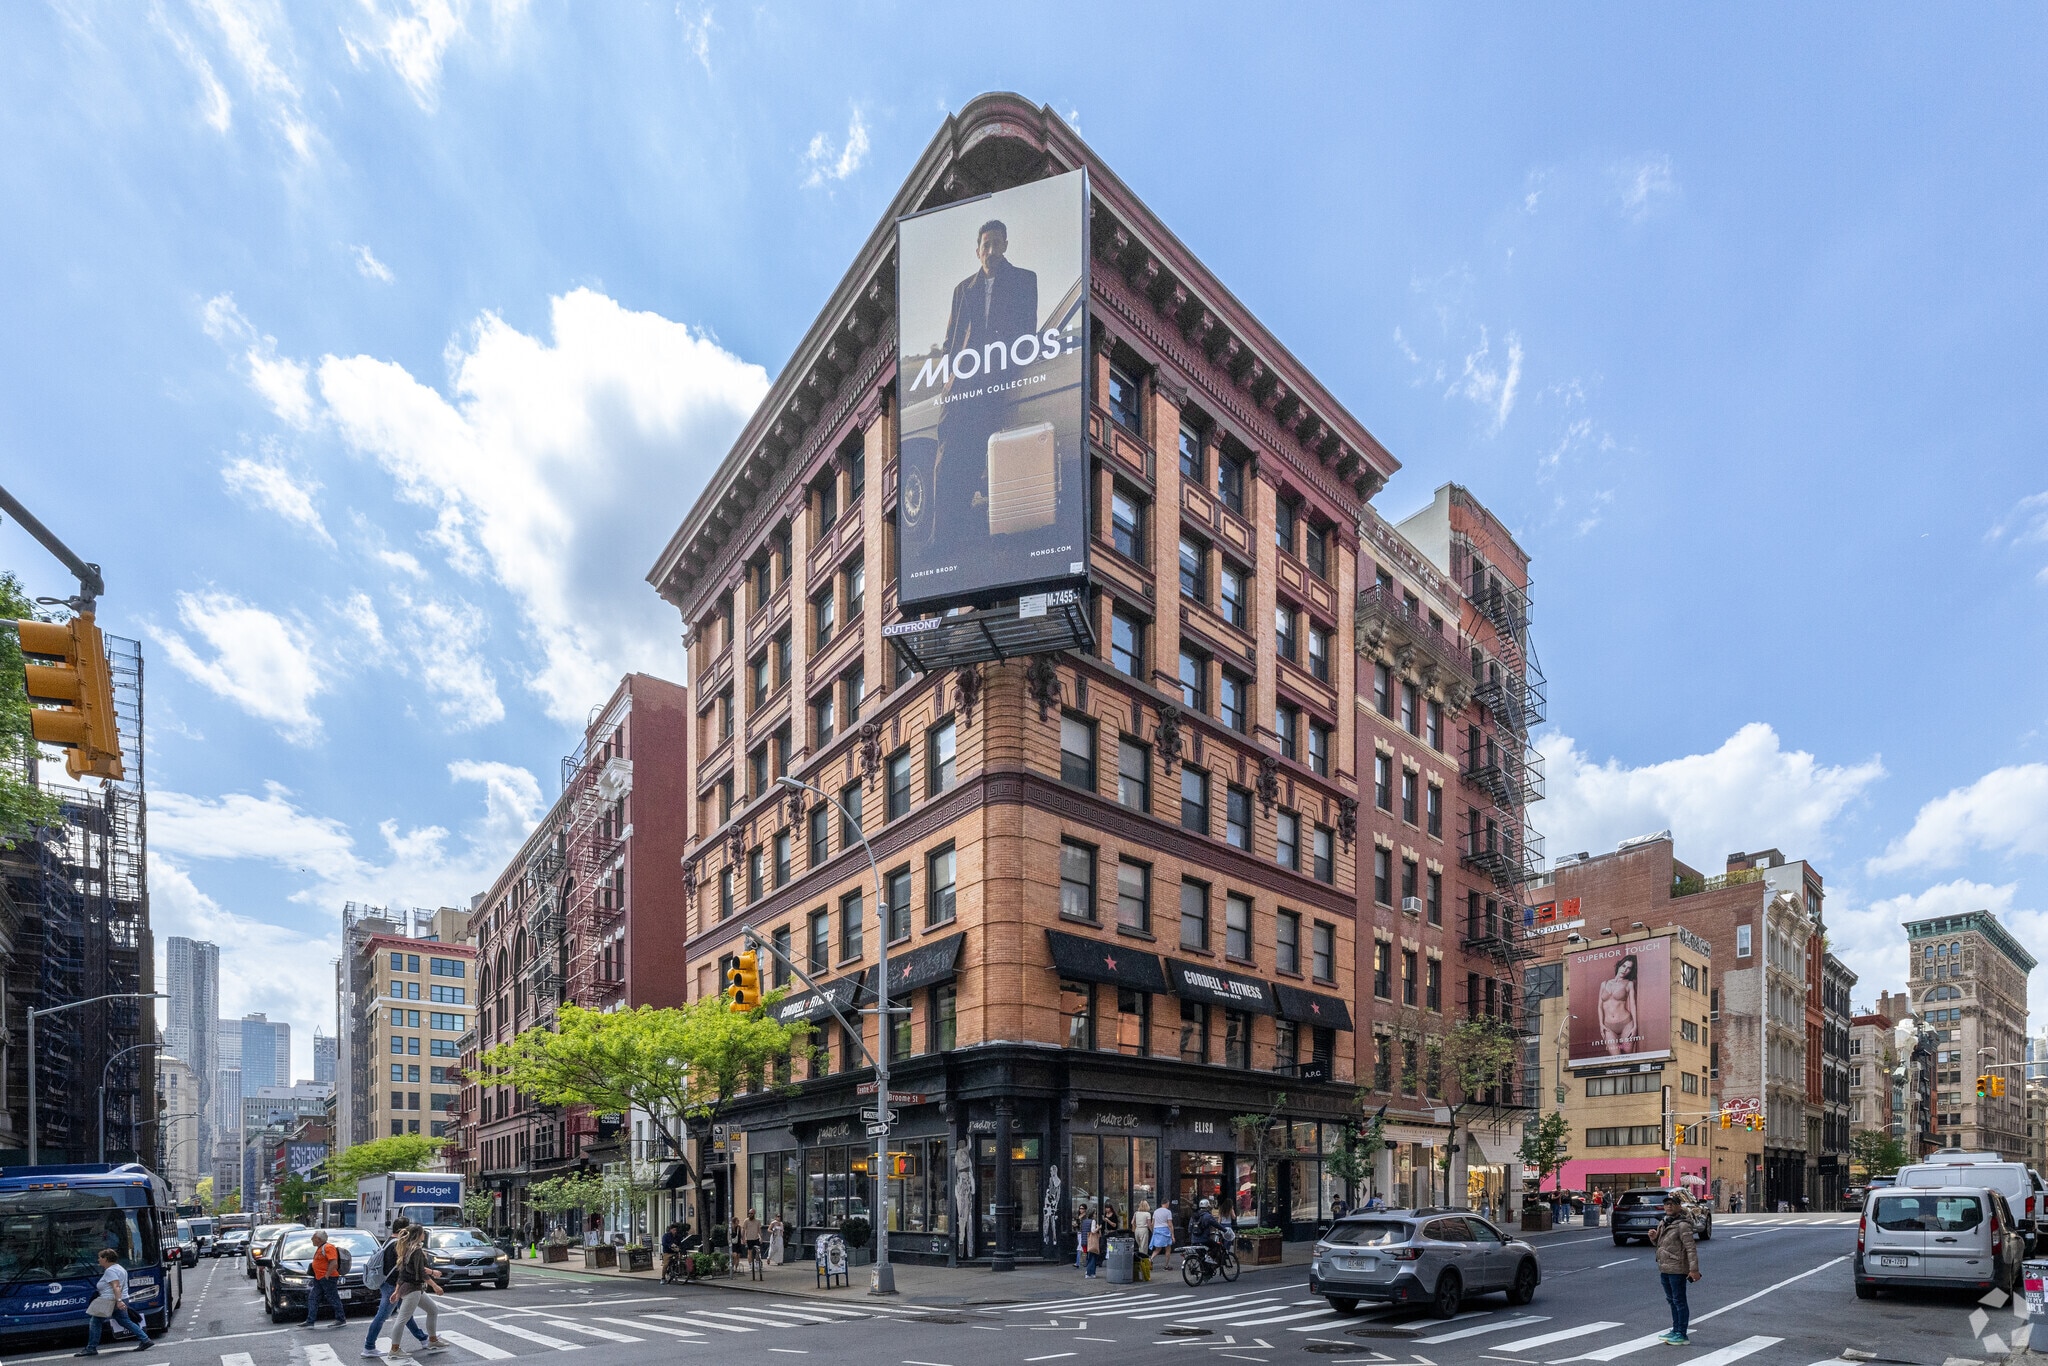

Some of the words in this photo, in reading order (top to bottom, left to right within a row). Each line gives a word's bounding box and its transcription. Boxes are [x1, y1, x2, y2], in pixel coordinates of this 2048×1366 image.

[933, 388, 983, 406] ALUMINUM
[987, 374, 1047, 394] COLLECTION
[1030, 545, 1072, 557] MONOS.COM
[910, 569, 934, 579] ADRIEN
[936, 565, 958, 574] BRODY
[883, 618, 940, 635] OUTFRONT
[1546, 922, 1571, 933] DAILY
[1577, 949, 1622, 964] SUPERIOR
[1625, 942, 1660, 955] TOUCH
[1183, 970, 1223, 991] CORDELL
[1228, 980, 1263, 1000] FITNESS
[1591, 1035, 1645, 1047] intimissimi
[889, 1094, 911, 1102] Broome
[912, 1095, 918, 1103] St
[1194, 1121, 1214, 1134] ELISA
[417, 1186, 451, 1197] Budget
[365, 1191, 383, 1221] Budget
